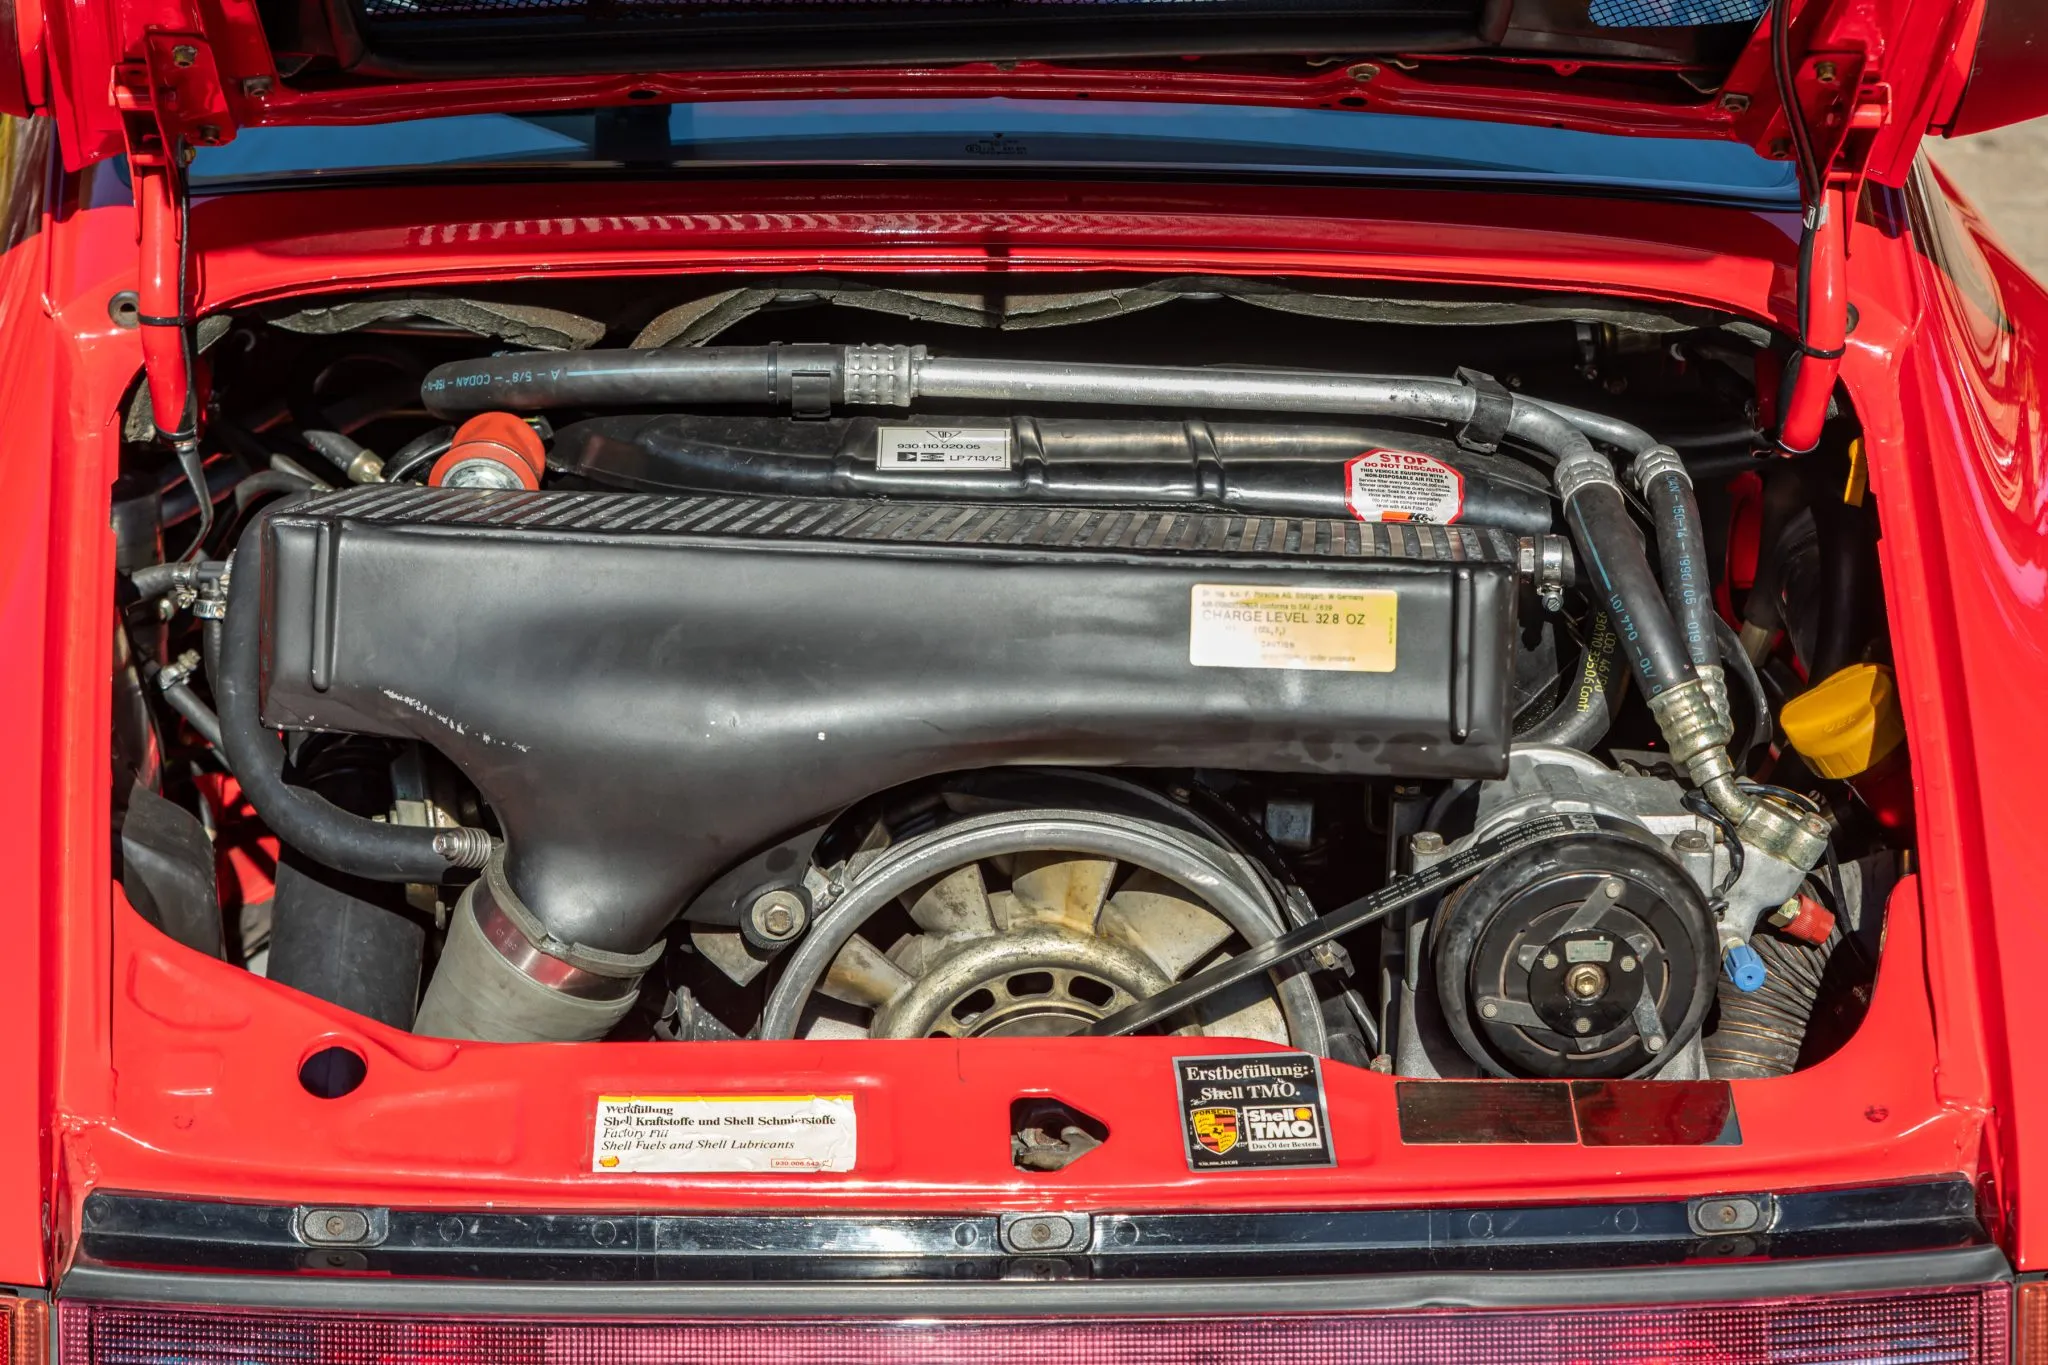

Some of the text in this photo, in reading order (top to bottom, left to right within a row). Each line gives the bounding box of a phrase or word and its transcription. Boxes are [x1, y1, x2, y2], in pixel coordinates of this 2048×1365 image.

[456, 374, 490, 387] CODAN
[1380, 454, 1428, 465] STOP
[1404, 465, 1445, 473] DISCARD
[1202, 609, 1262, 622] CHARGE
[1267, 612, 1308, 623] LEVEL
[1346, 614, 1365, 625] OZ
[1186, 1065, 1309, 1081] Erstbefüllung:
[1201, 1082, 1300, 1101] Shell TMO.
[636, 1116, 695, 1126] Kraftstoffe
[699, 1117, 720, 1126] und
[724, 1116, 754, 1126] Shell
[758, 1115, 836, 1126] Schmierstoffe
[1250, 1109, 1295, 1122] Shell
[603, 1128, 646, 1139] Factory
[1250, 1122, 1313, 1139] TMO
[602, 1139, 795, 1151] Shell Fuels and Shell Lubricants
[1268, 1141, 1277, 1149] Öl
